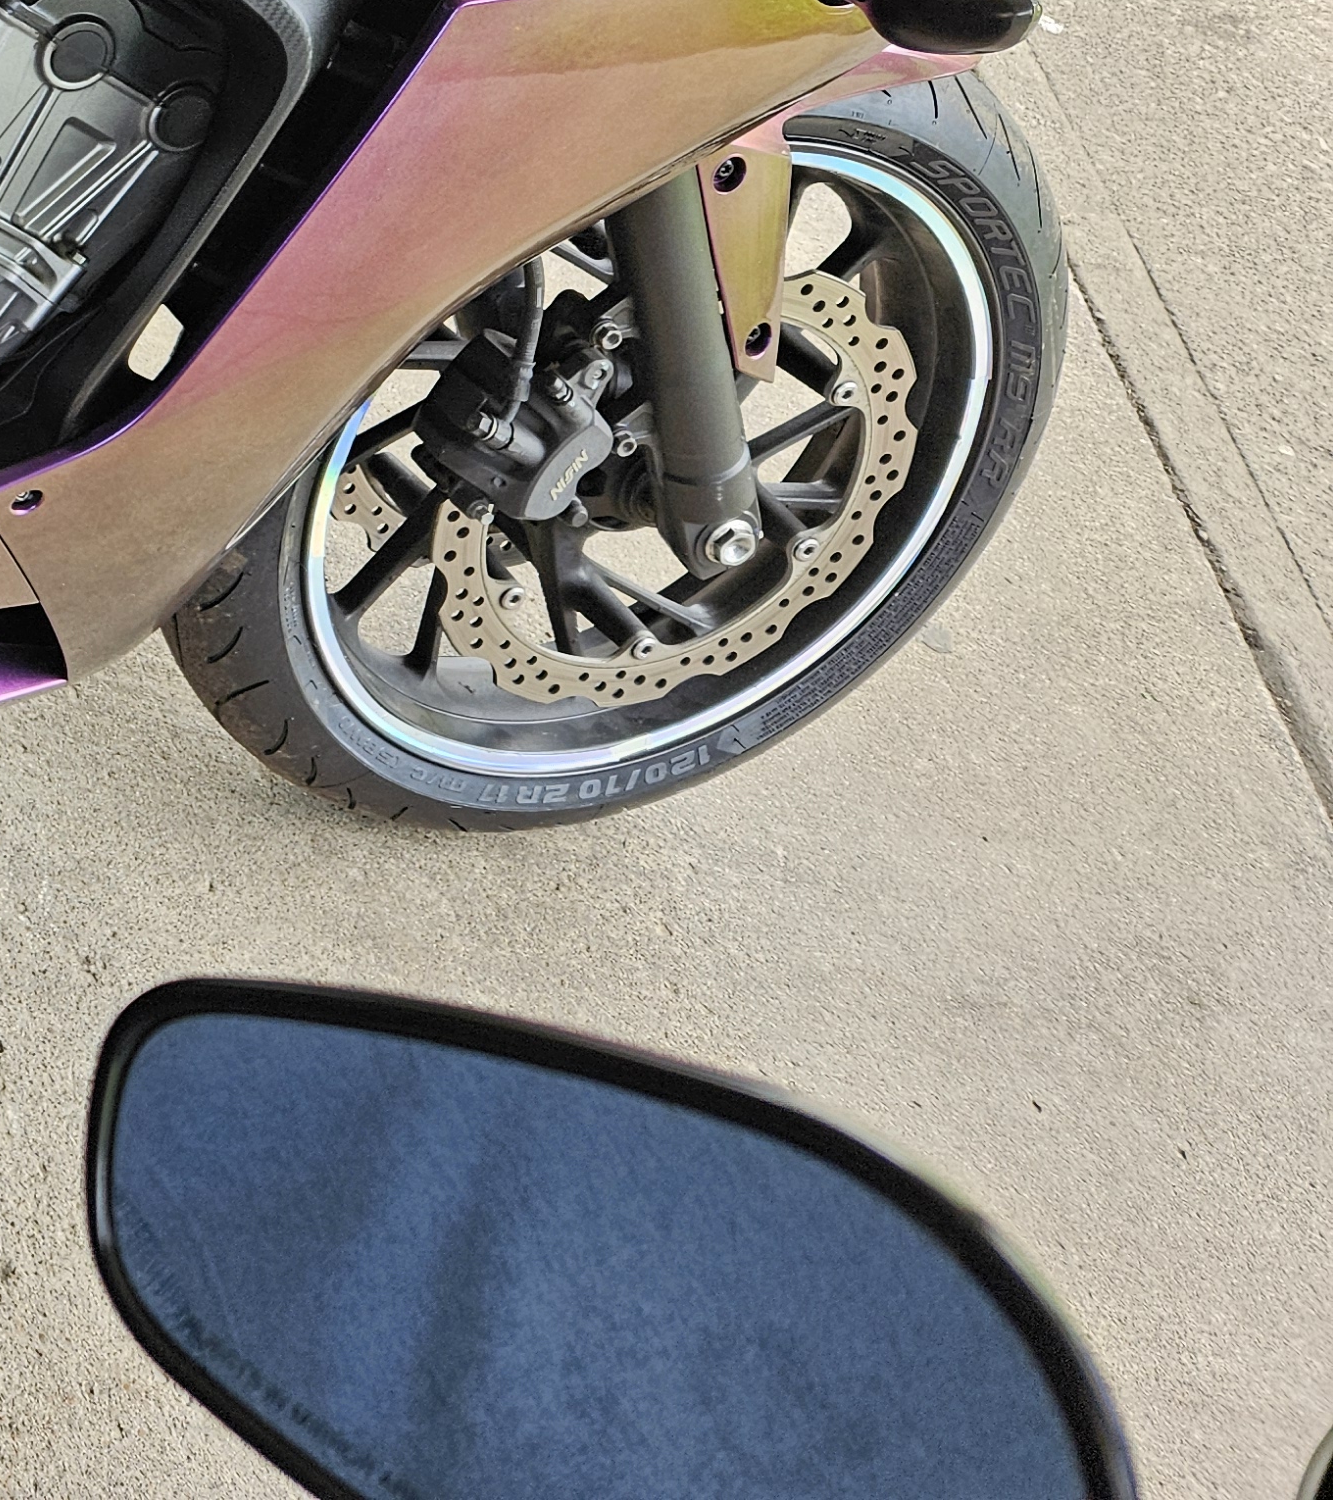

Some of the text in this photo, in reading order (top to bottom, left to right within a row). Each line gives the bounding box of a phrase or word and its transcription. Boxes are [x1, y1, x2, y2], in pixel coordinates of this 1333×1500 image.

[910, 159, 1036, 499] SPORTEC M9 RR
[550, 448, 589, 501] NISSIN
[477, 782, 571, 805] ZR17
[578, 743, 711, 801] 120/70
